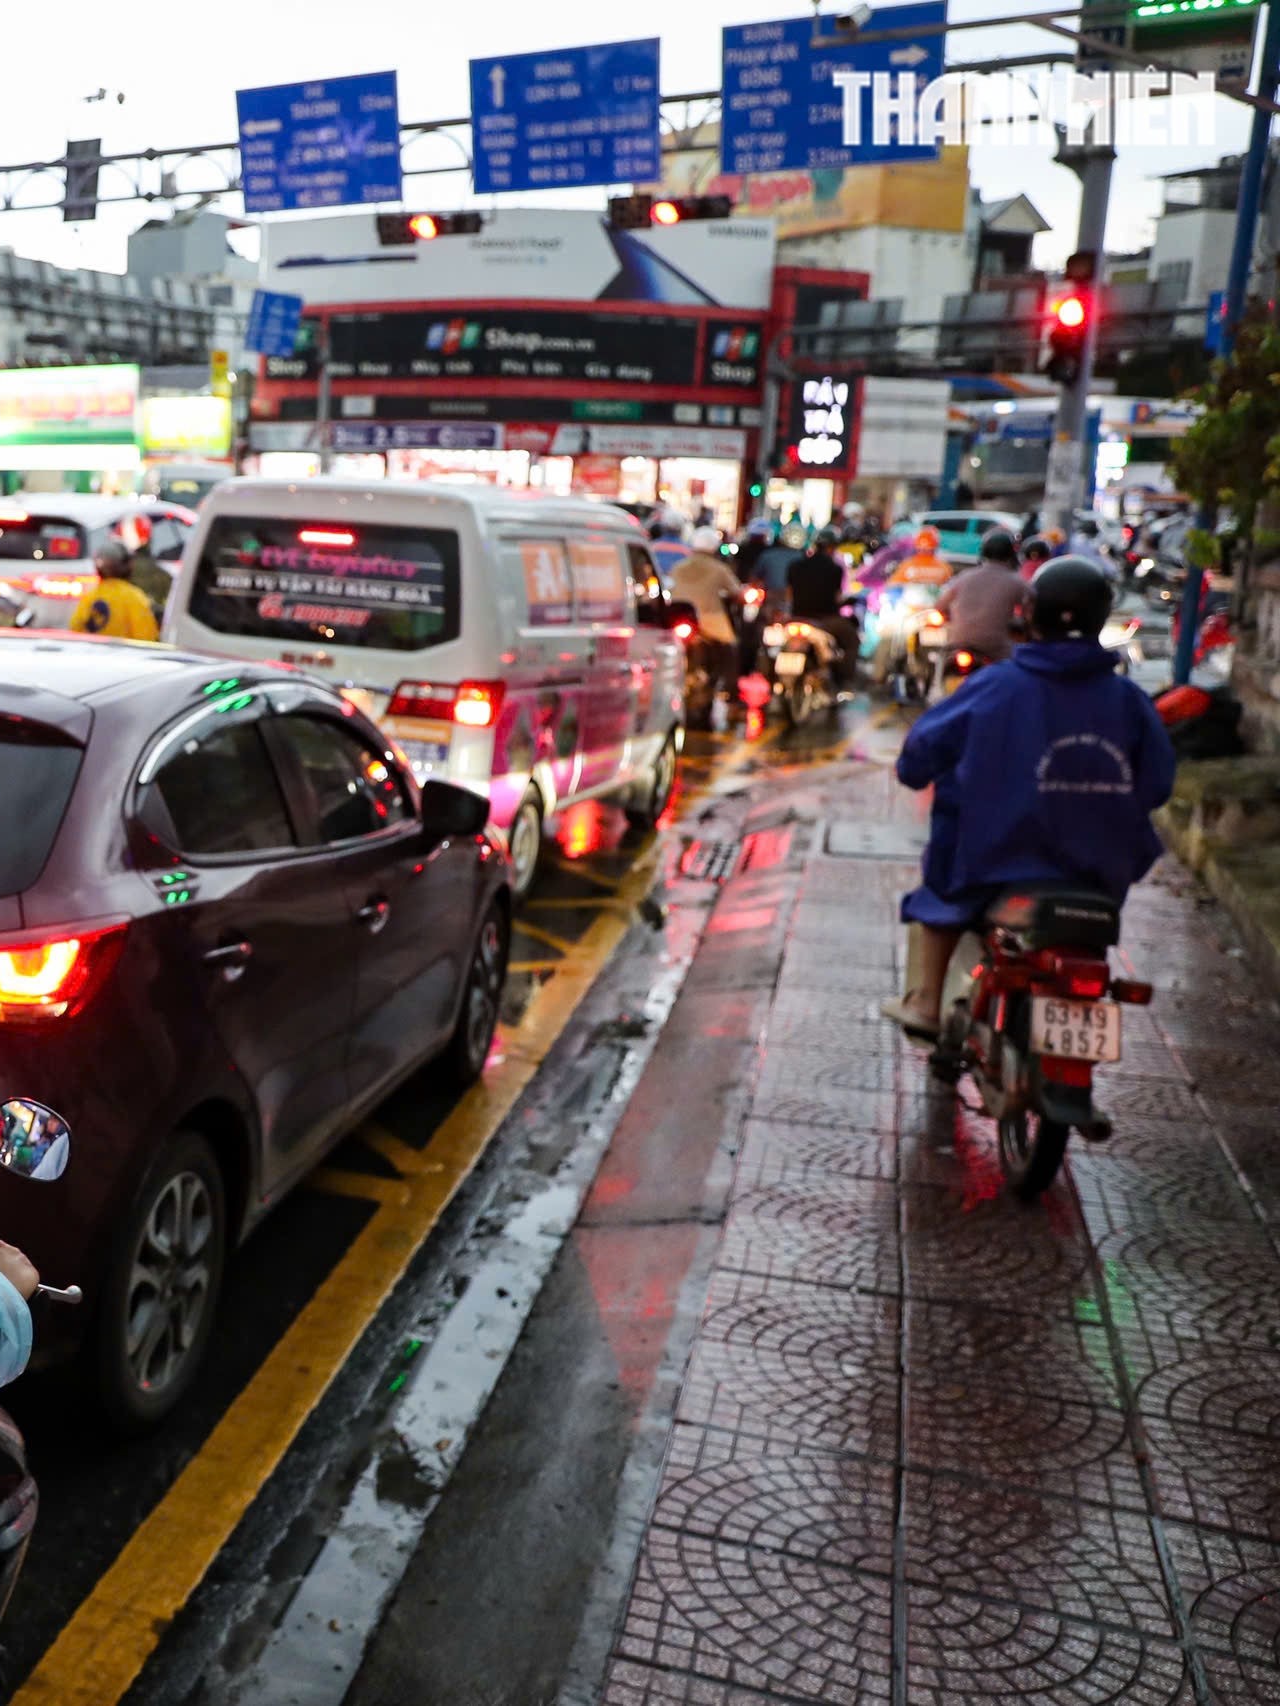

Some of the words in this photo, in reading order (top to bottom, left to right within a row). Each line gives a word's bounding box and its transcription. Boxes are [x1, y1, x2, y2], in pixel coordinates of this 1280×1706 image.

[426, 318, 481, 355] FPT
[712, 327, 760, 362] FPT
[712, 362, 757, 384] Shop
[1043, 1028, 1107, 1056] 4852
